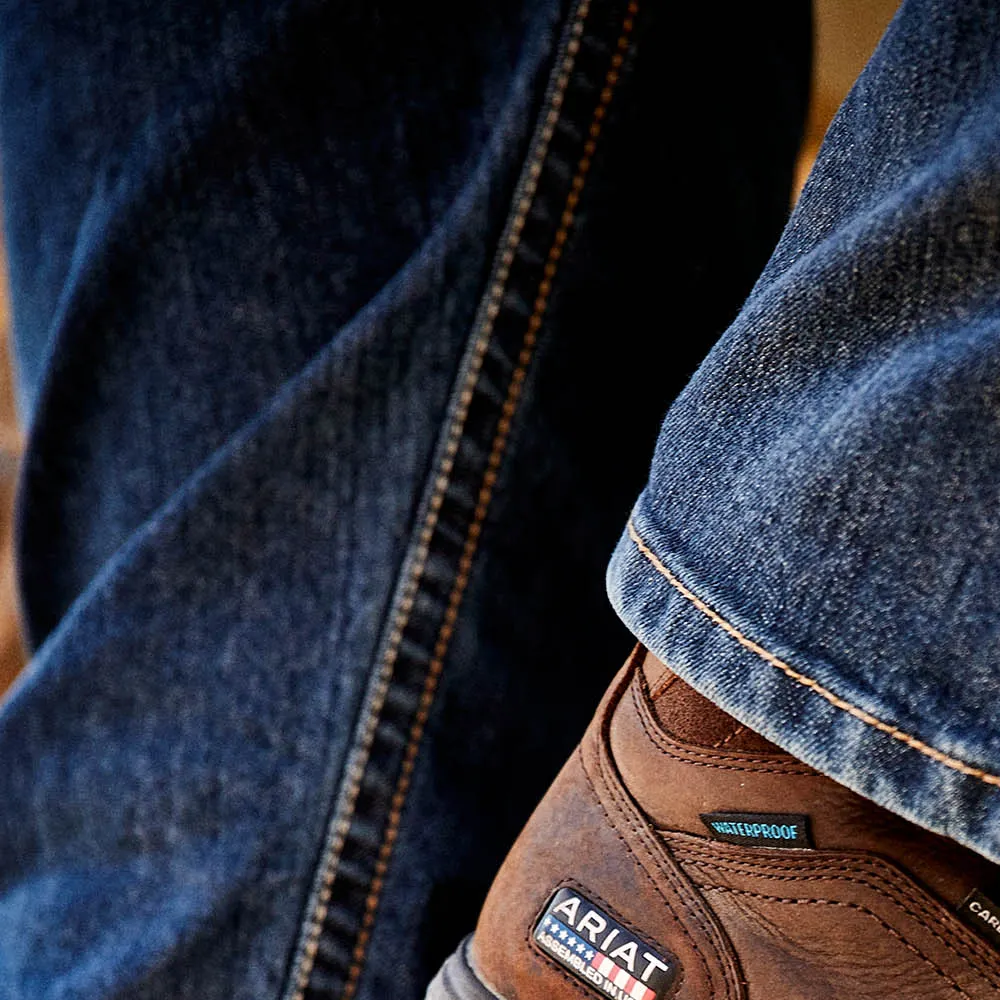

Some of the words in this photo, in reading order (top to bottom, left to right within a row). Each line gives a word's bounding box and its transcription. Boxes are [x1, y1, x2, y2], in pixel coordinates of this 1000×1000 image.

[711, 822, 798, 839] WATERPROOF
[537, 931, 603, 985] ASSEMBLED
[603, 980, 618, 998] IN
[553, 896, 669, 982] ARIAT
